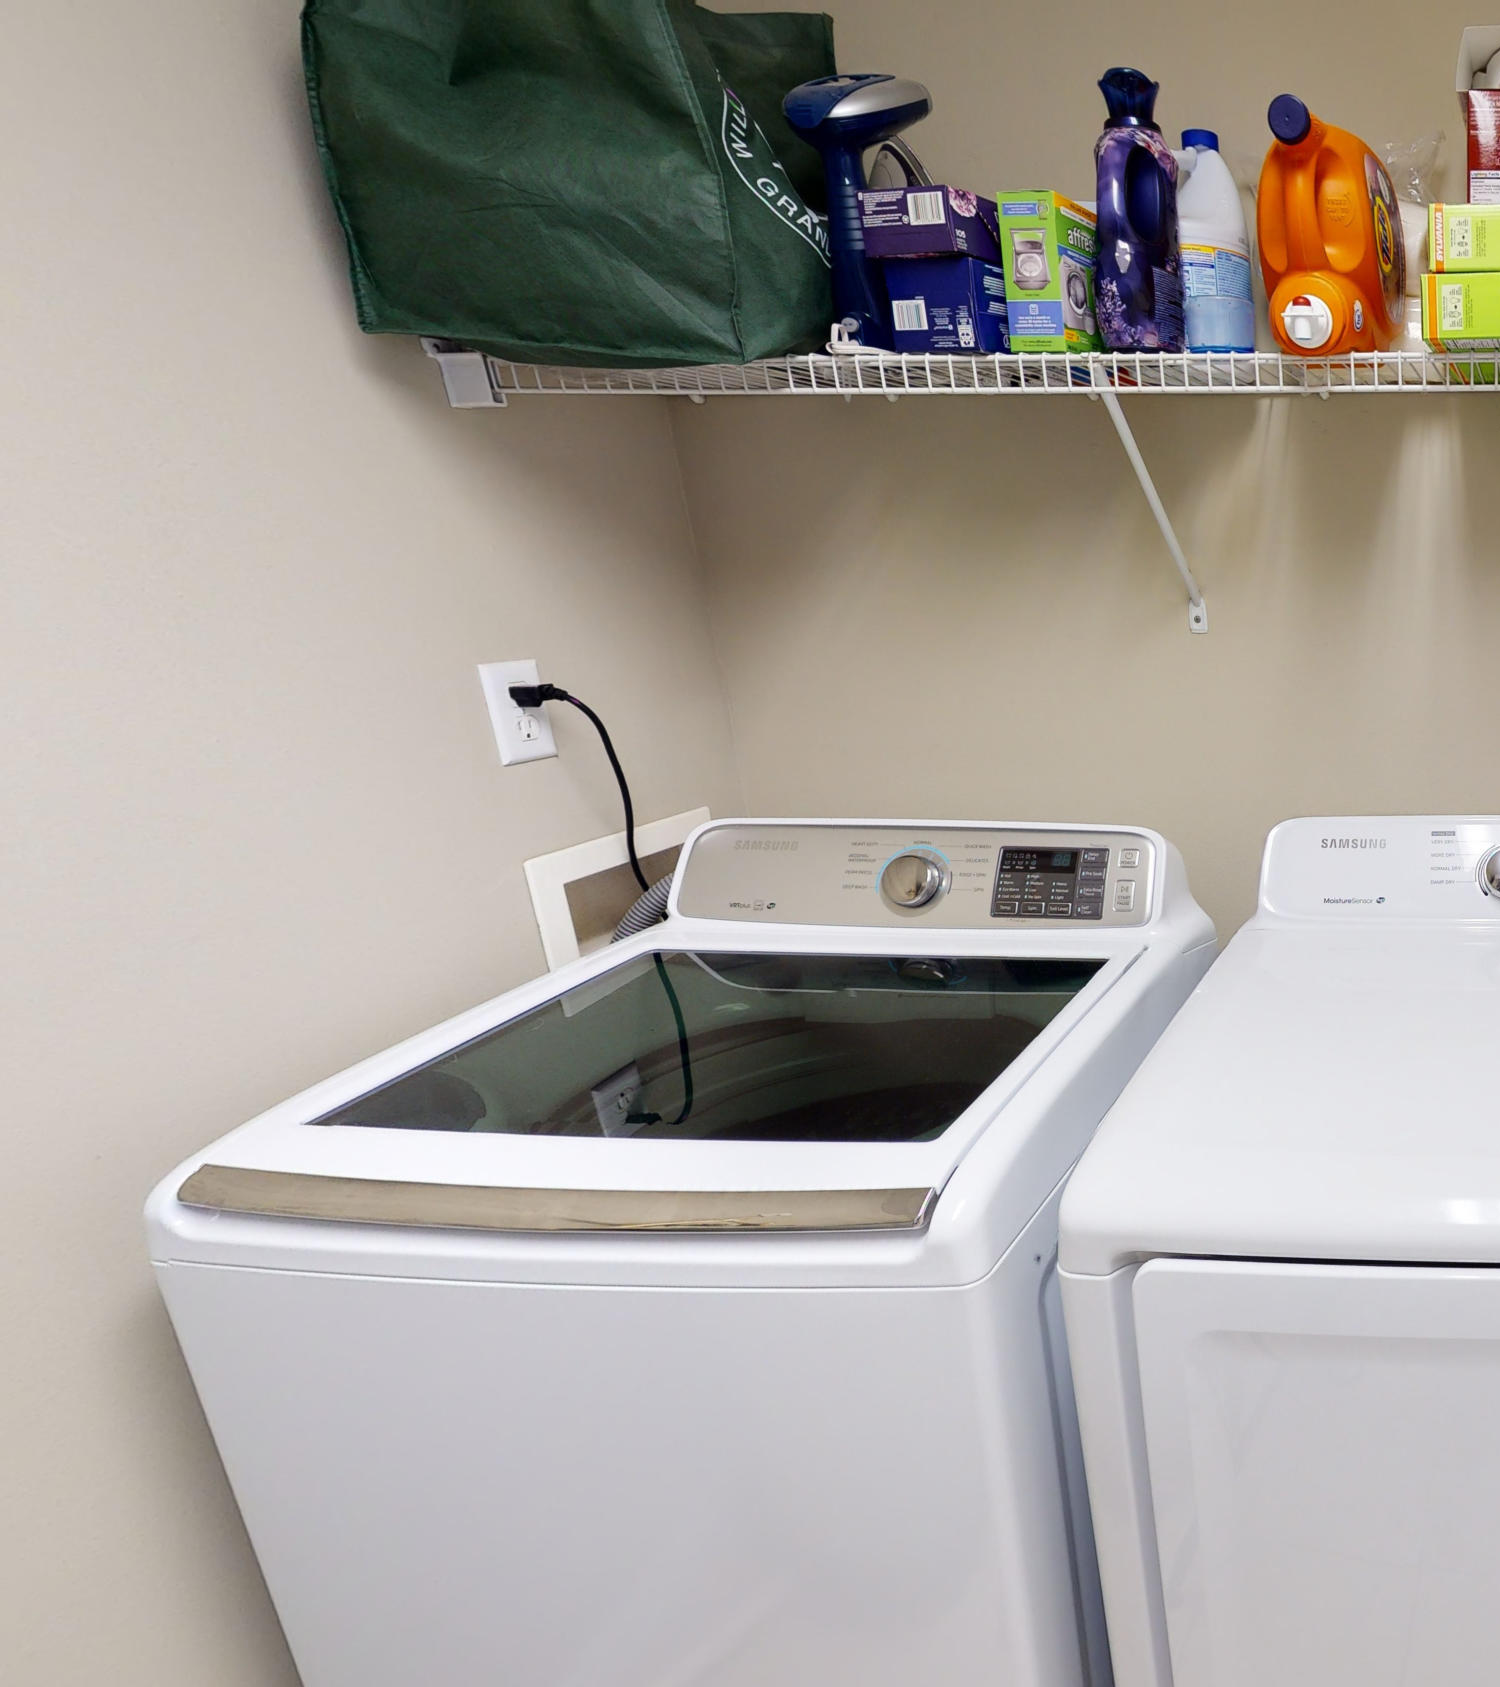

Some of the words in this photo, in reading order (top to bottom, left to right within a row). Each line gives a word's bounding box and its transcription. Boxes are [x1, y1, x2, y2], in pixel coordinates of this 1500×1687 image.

[1068, 227, 1097, 254] affres
[1435, 212, 1443, 261] SYLVANIA
[734, 840, 799, 851] SAMSUNG
[1321, 838, 1387, 849] SAMSUNG
